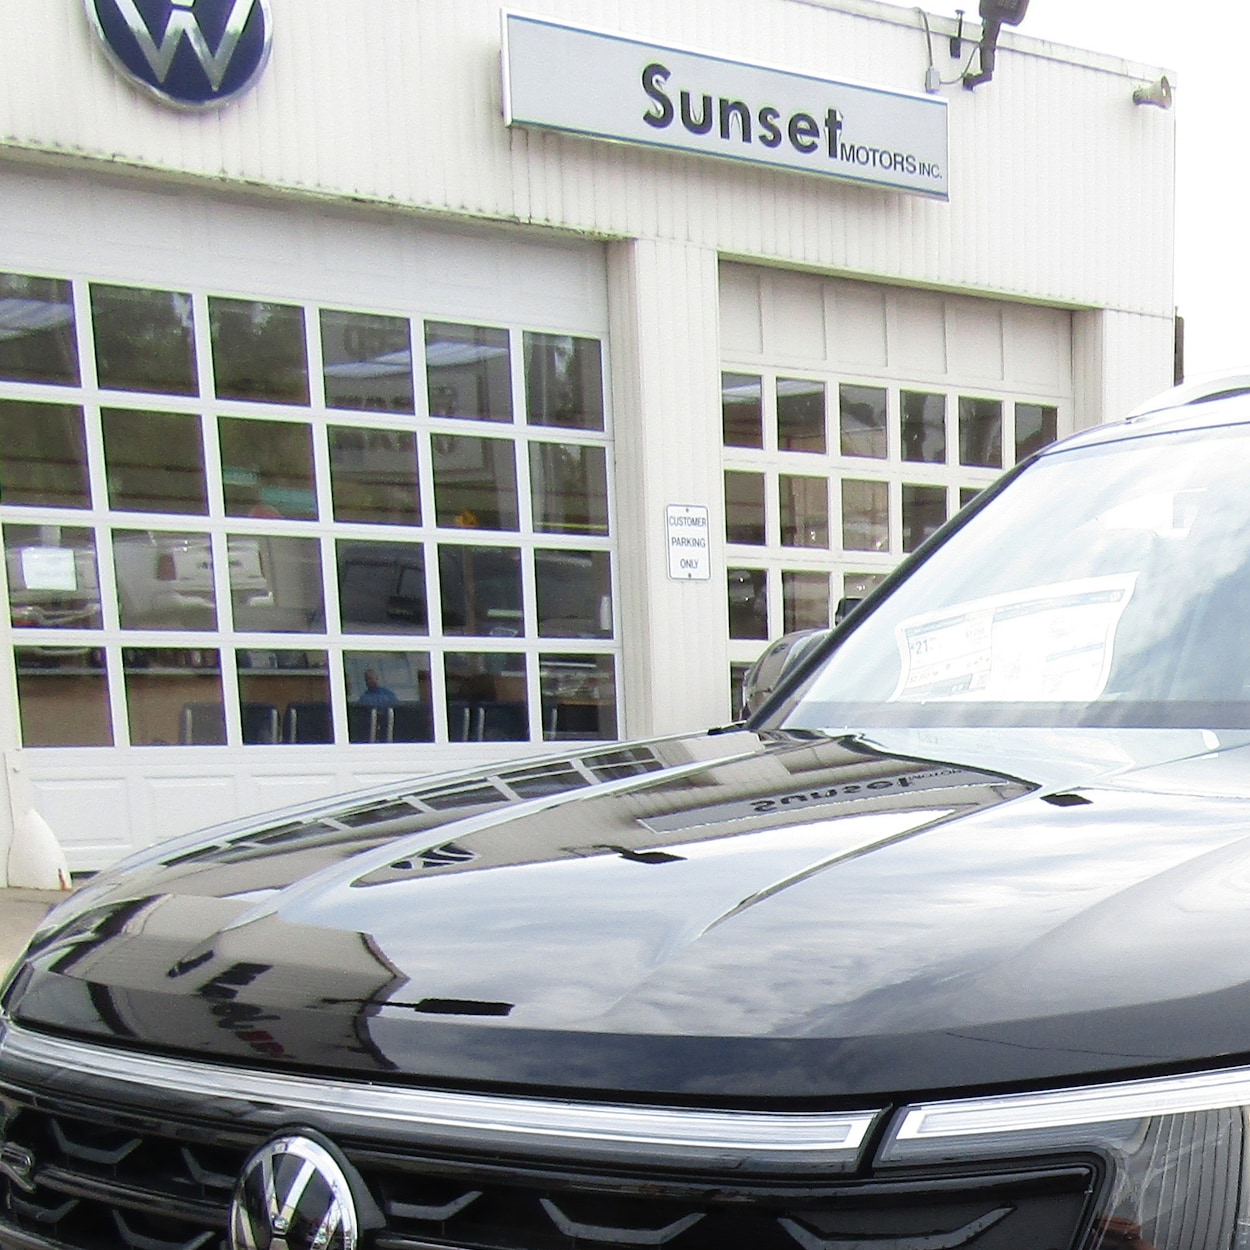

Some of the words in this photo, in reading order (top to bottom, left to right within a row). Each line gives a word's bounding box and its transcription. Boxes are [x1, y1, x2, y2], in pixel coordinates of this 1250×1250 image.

[641, 62, 843, 159] Sunset
[840, 142, 917, 174] MOTORS
[919, 162, 943, 179] INC.
[668, 516, 706, 527] CUSTOMER
[671, 537, 706, 548] PARKING
[680, 558, 699, 569] ONLY
